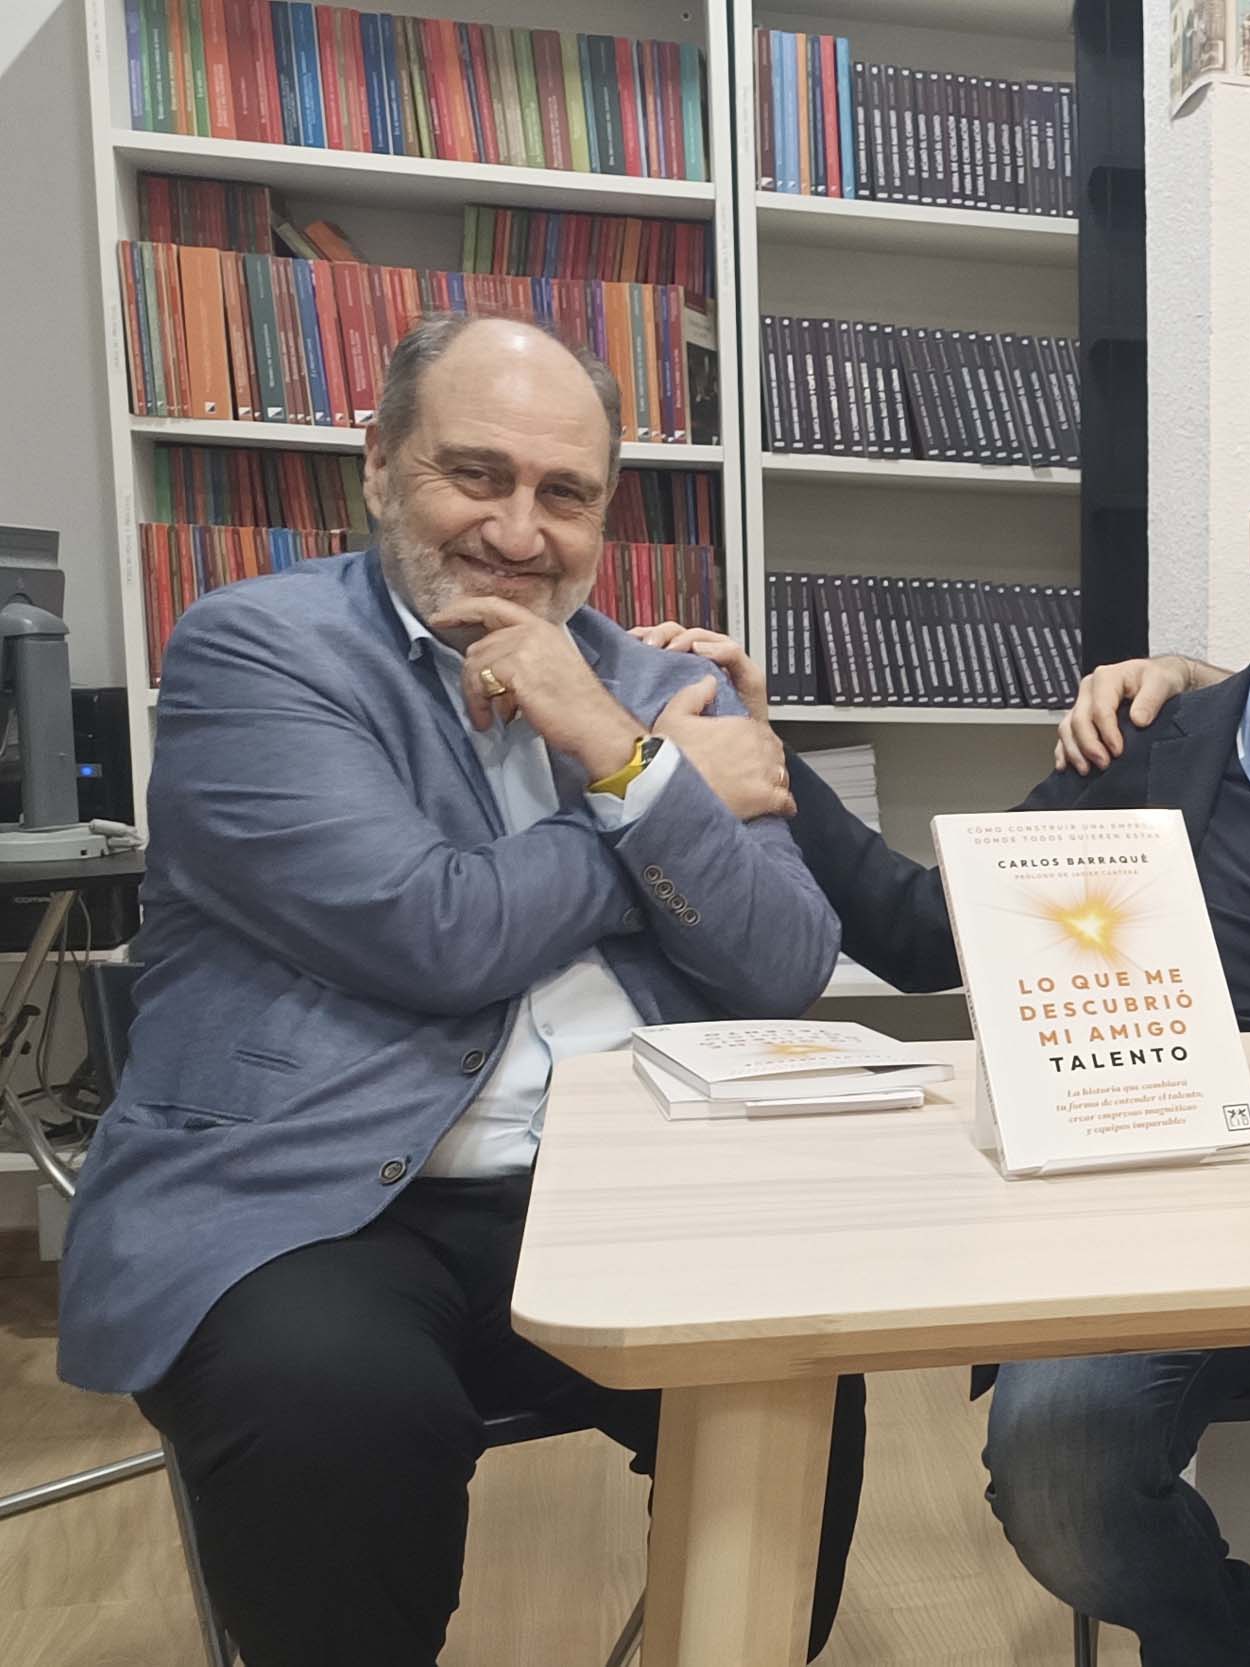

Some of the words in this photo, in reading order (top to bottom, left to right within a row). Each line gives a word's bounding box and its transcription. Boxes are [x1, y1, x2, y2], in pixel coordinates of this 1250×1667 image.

[1008, 824, 1076, 833] CONSTRUIR
[998, 857, 1060, 869] CARLOS
[1067, 854, 1149, 866] BARRAQUÉ
[1018, 977, 1056, 995] LO
[1071, 971, 1131, 990] QUE
[1144, 968, 1183, 985] ME
[1019, 989, 1193, 1022] DESCUBRIÓ
[1038, 1028, 1072, 1047] MI
[1089, 1020, 1187, 1043] AMIGO
[1049, 1046, 1188, 1073] TALENTO
[1082, 1084, 1122, 1096] historia
[1067, 1100, 1099, 1113] forma
[1101, 1097, 1113, 1107] de
[1114, 1094, 1156, 1106] entender
